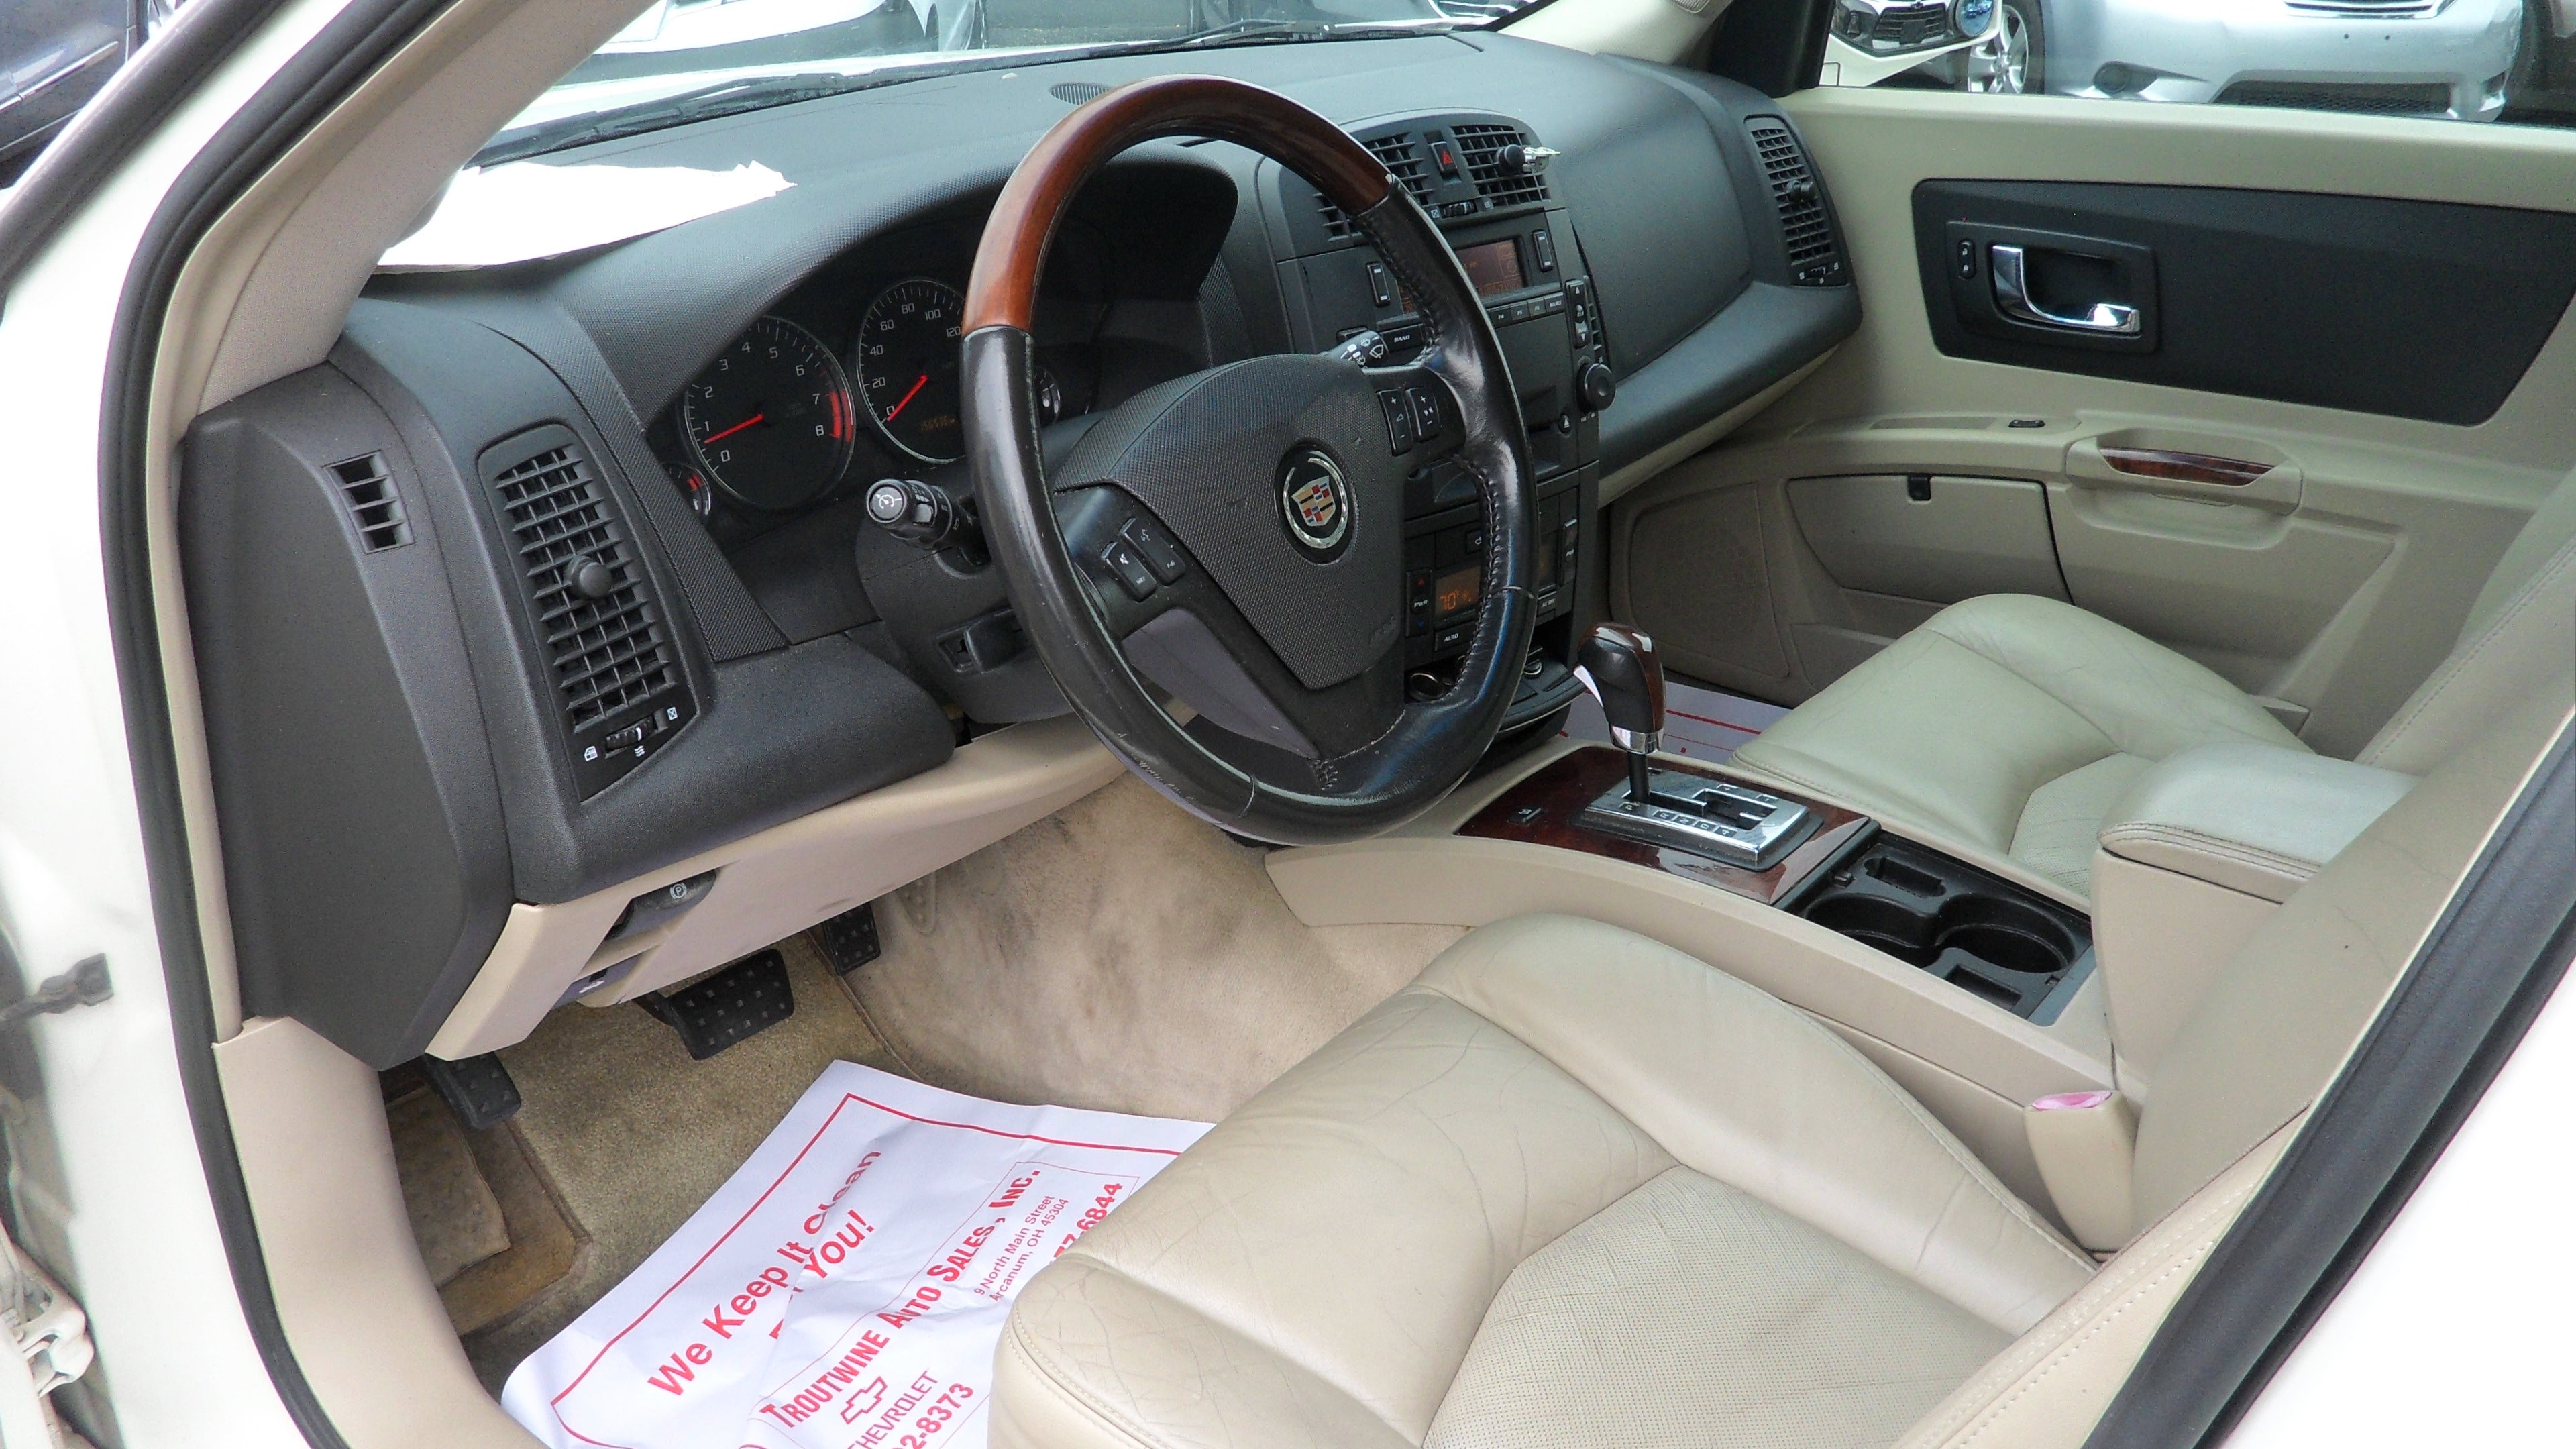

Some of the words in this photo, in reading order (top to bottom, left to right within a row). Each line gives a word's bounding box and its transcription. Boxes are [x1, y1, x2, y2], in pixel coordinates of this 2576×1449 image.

[901, 303, 915, 315] 80
[924, 309, 941, 321] 100
[880, 319, 895, 331] 60
[946, 326, 961, 338] 120
[1393, 335, 1411, 343] BAND
[741, 341, 751, 353] 4
[769, 347, 779, 359] 5
[869, 345, 884, 356] 40
[719, 358, 729, 371] 3
[796, 364, 805, 376] 6
[872, 376, 885, 389] 20
[704, 386, 714, 398] 2
[812, 393, 820, 405] 7
[886, 405, 896, 415] 0
[704, 421, 710, 433] 1
[815, 425, 824, 437] 8
[720, 449, 731, 462] 0
[1444, 633, 1459, 643] AUTO
[974, 1287, 985, 1295] 9
[980, 1256, 1010, 1289] North
[1004, 1227, 1030, 1254] Main
[1025, 1195, 1055, 1225] Street
[989, 1251, 1034, 1302] Arcanum,
[1027, 1229, 1045, 1248] OH
[1041, 1198, 1069, 1227] 45304
[647, 1343, 712, 1395] We
[702, 1267, 789, 1339] Keep
[777, 1242, 814, 1264] It
[892, 1383, 975, 1449] 2-8373
